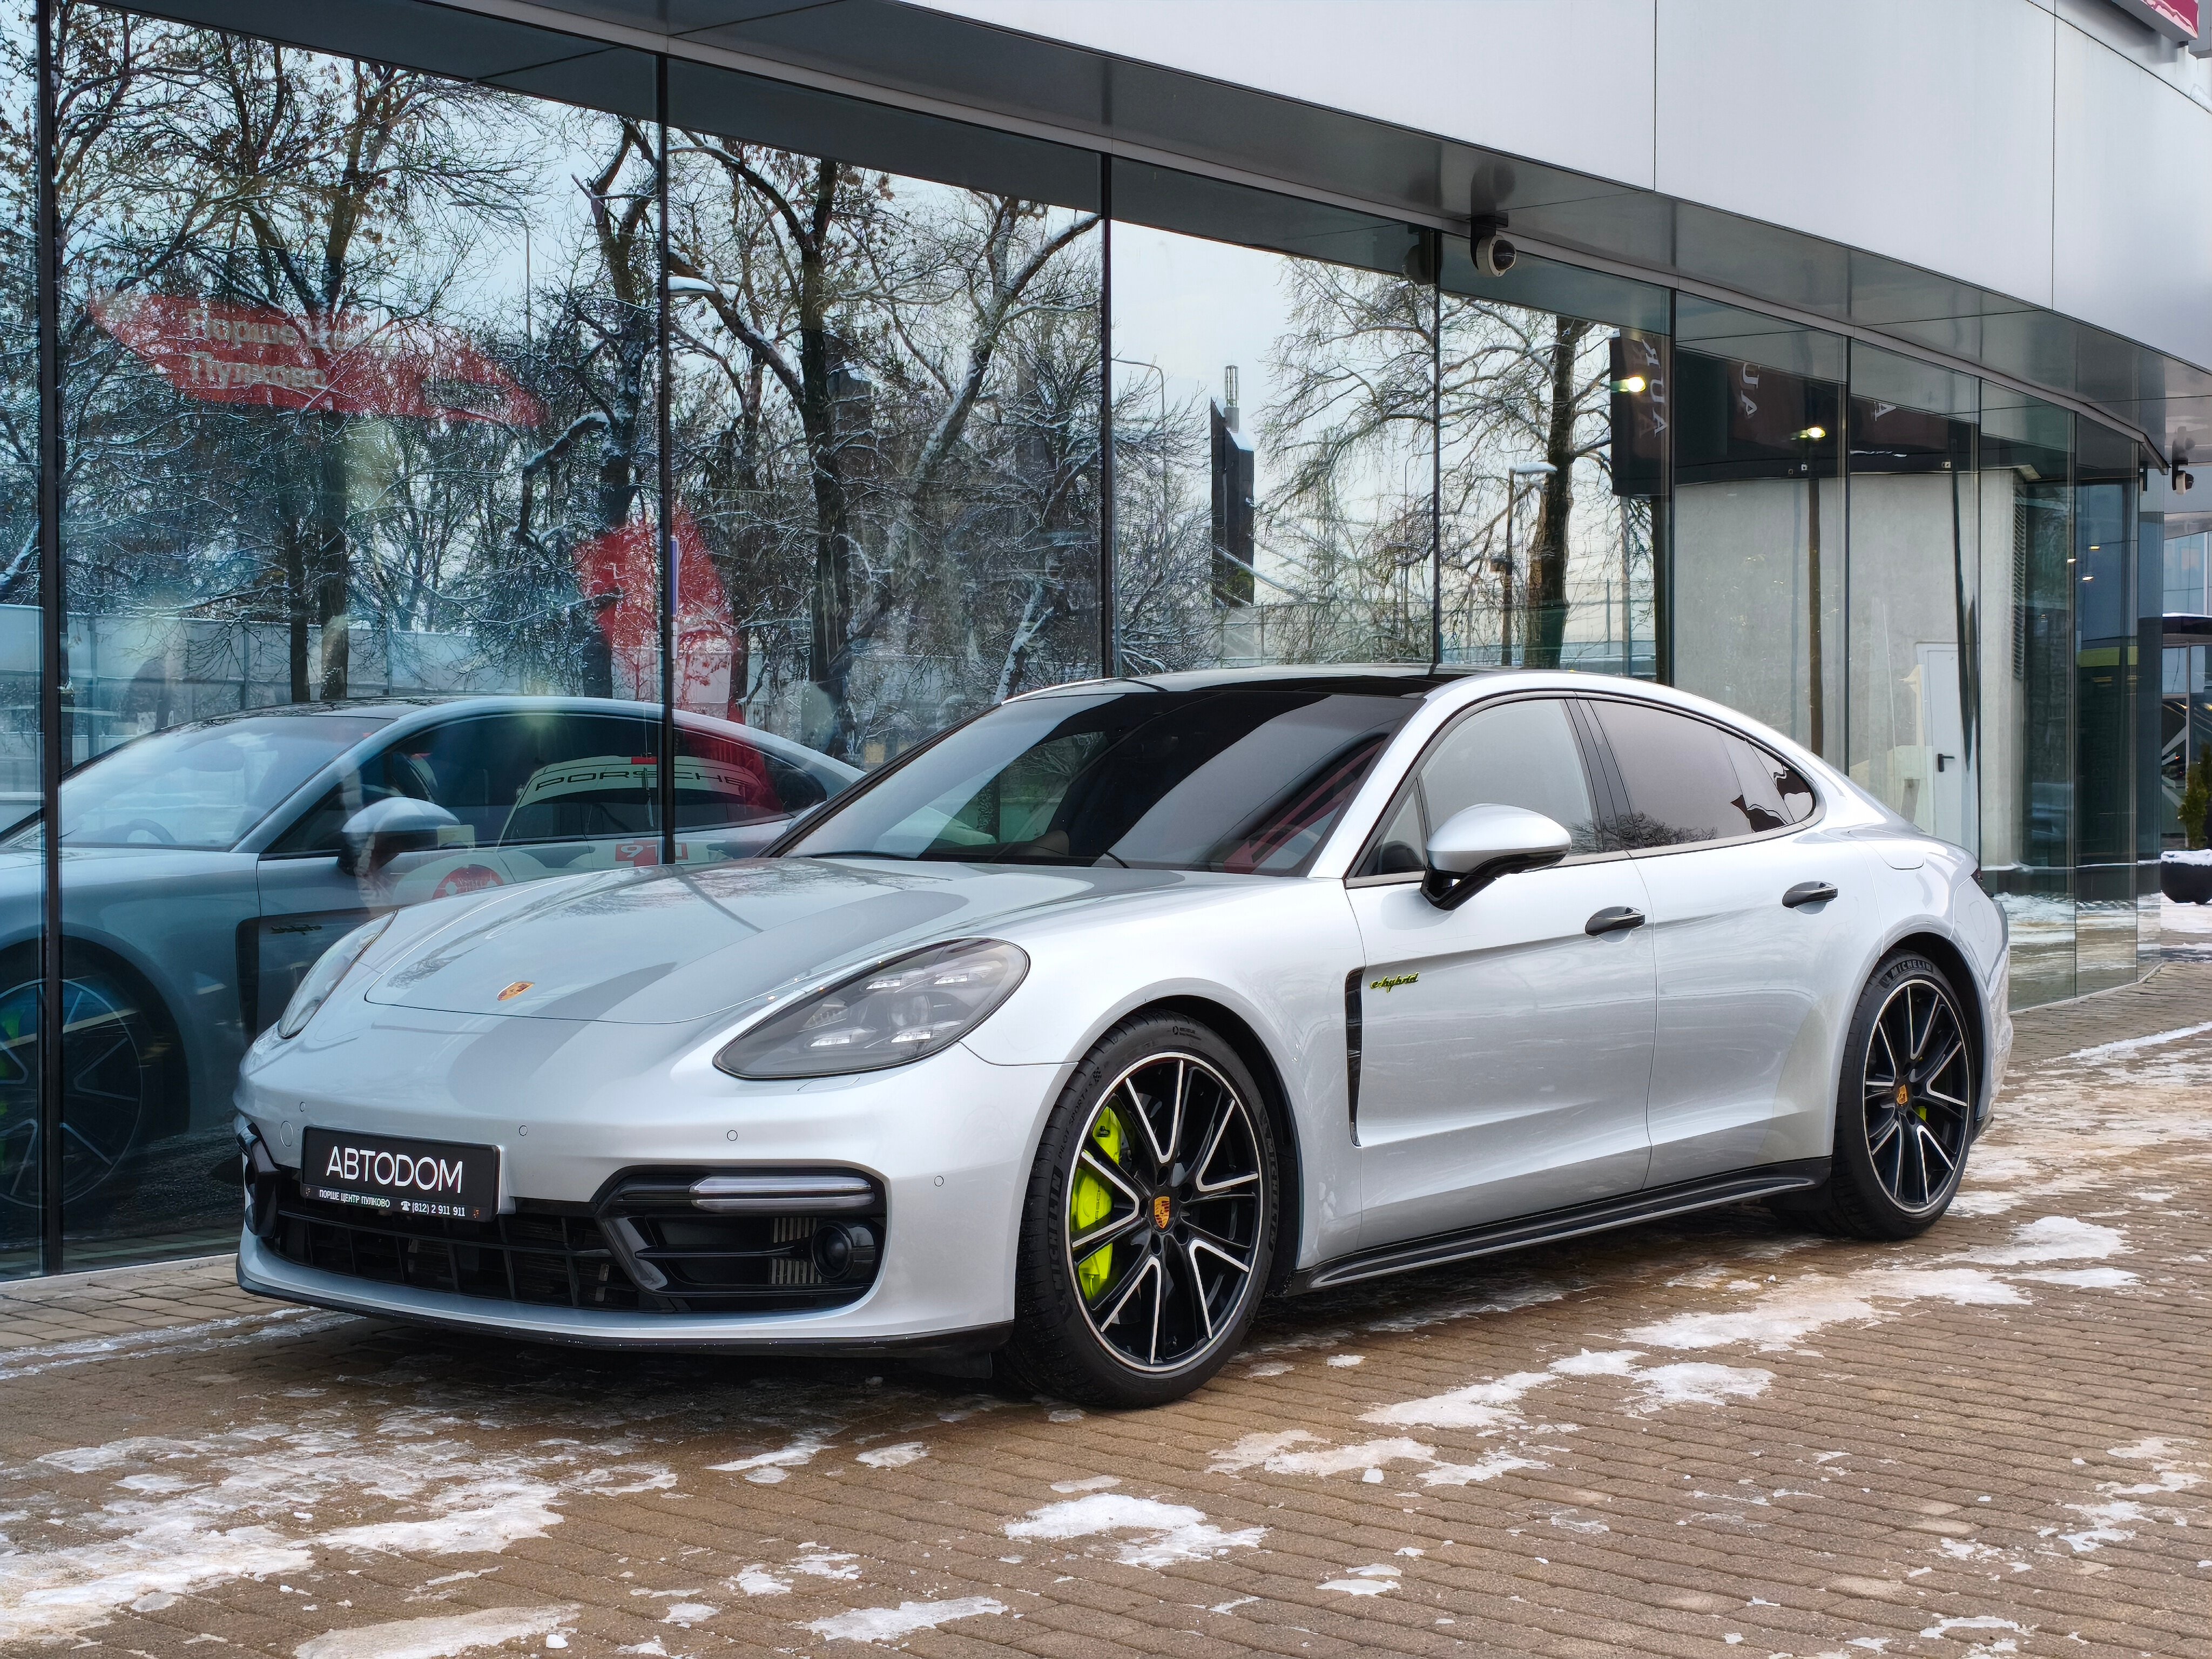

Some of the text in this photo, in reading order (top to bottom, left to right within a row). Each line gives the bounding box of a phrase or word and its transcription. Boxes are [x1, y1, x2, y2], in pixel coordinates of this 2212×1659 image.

[1891, 960, 1931, 977] MICHELIN
[1058, 1127, 1070, 1159] PILOT
[1069, 1092, 1087, 1127] SPORT
[319, 1189, 390, 1208] ПОРШЕ ЦЕНТР ПУЛКОВО
[412, 1203, 466, 1217] (812) 2 911 911
[1048, 1173, 1064, 1290] MICHELIN
